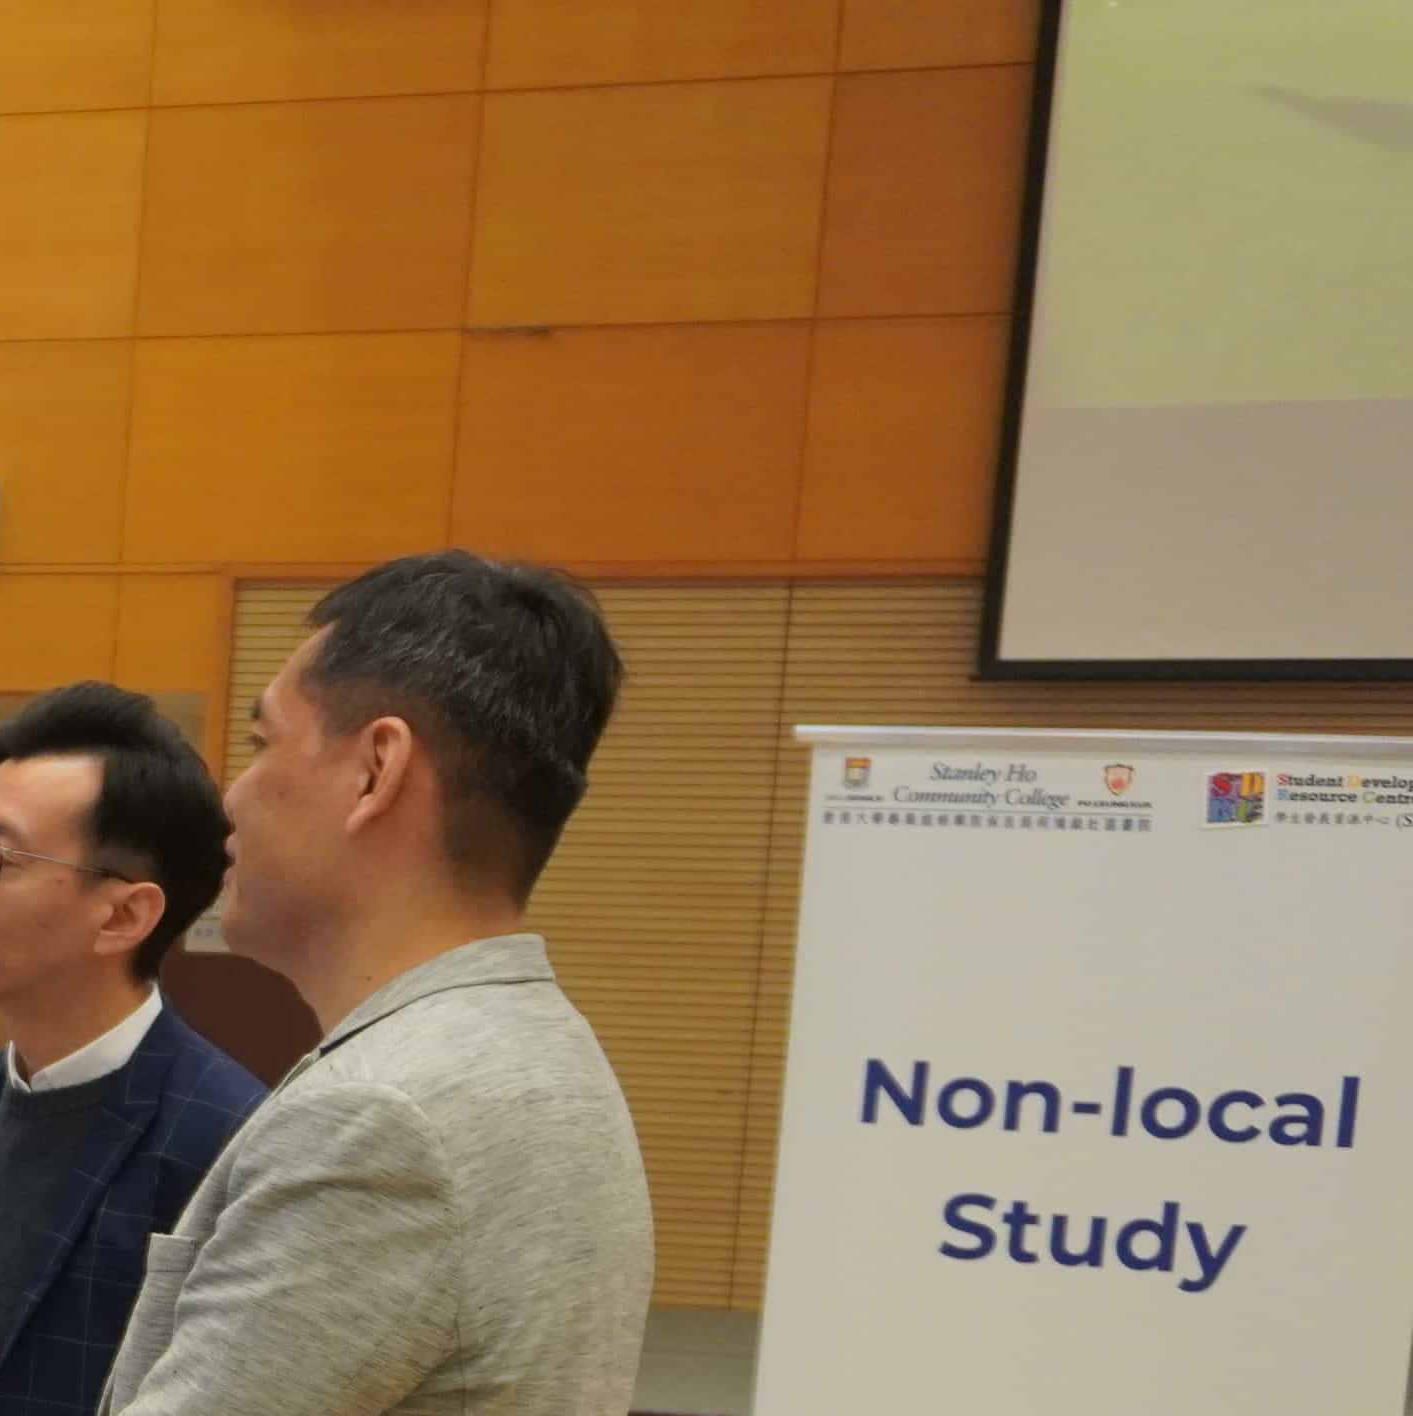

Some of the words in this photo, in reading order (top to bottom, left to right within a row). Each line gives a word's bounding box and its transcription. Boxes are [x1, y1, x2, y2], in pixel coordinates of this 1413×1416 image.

[929, 761, 1003, 786] Stanley
[1005, 763, 1038, 783] Ho
[1277, 773, 1343, 787] Student
[892, 785, 1003, 806] Community
[1005, 788, 1071, 810] College
[1276, 788, 1358, 803] Resource
[1363, 791, 1413, 805] Centr
[860, 1058, 1360, 1149] Non-local
[938, 1192, 1247, 1294] Study
